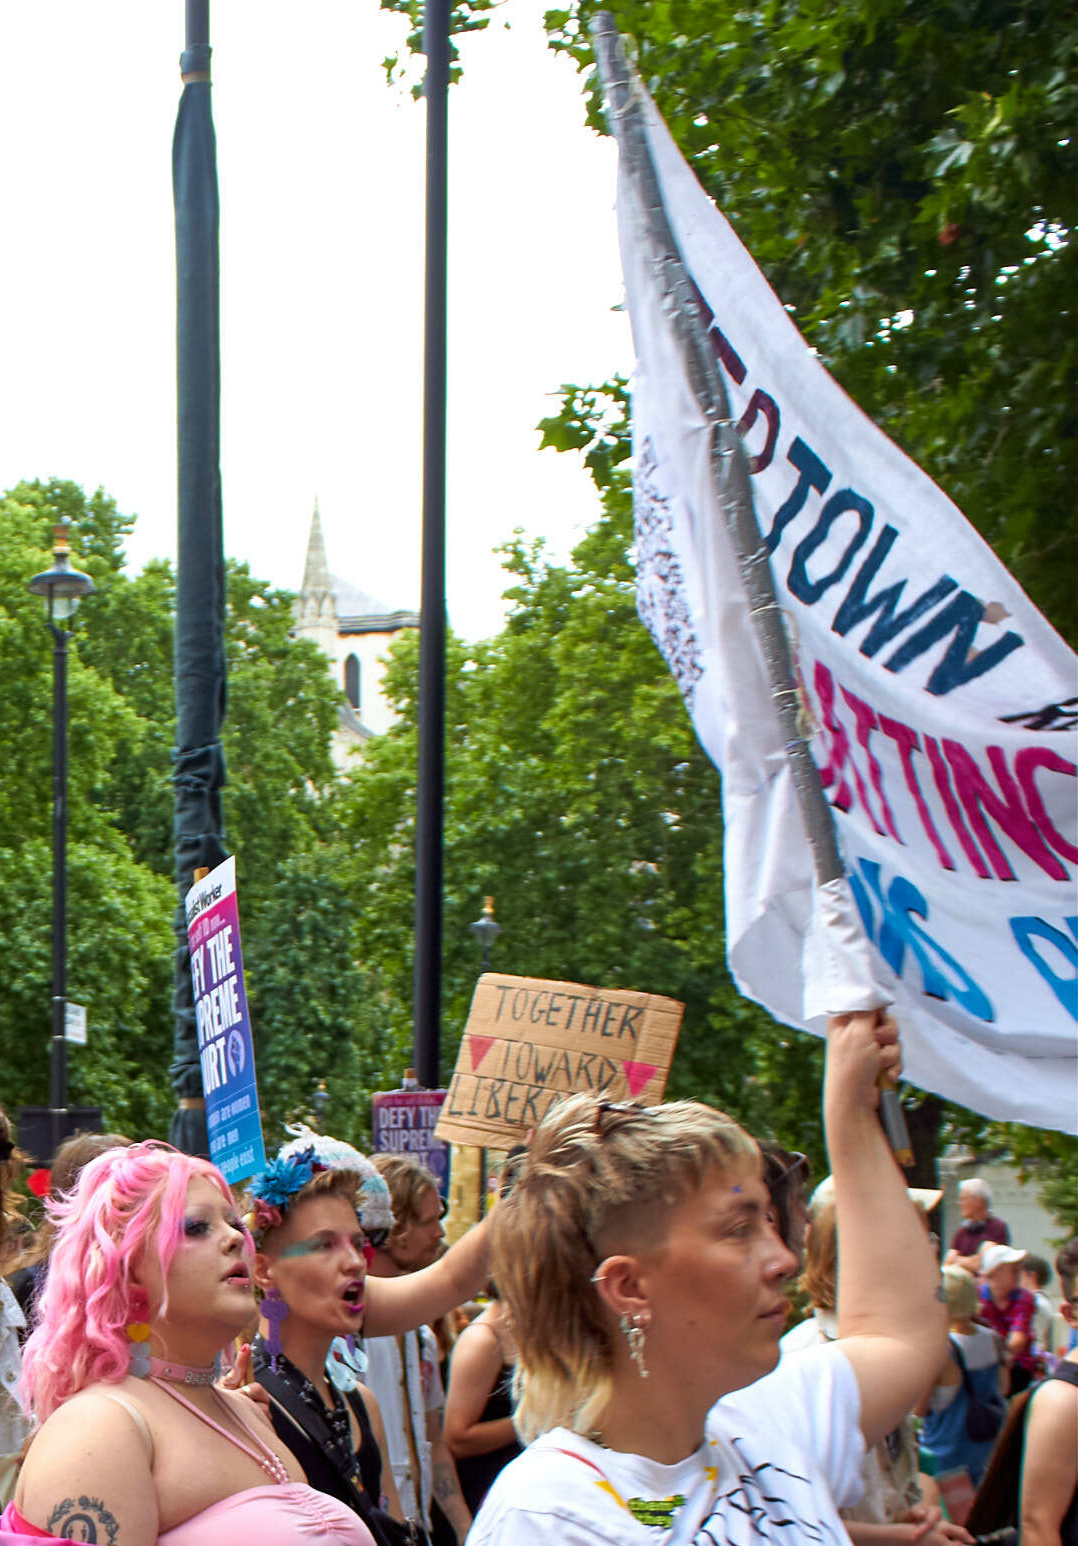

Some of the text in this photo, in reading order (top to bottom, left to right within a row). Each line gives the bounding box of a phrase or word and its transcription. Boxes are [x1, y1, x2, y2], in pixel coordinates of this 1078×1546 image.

[764, 435, 1025, 697] TOWN
[205, 924, 236, 985] THE
[195, 974, 243, 1050] PREME
[495, 984, 646, 1040] TOGETHER
[199, 1036, 229, 1098] URT
[501, 1038, 619, 1091] TOWARD
[378, 1105, 441, 1129] DEFY TH
